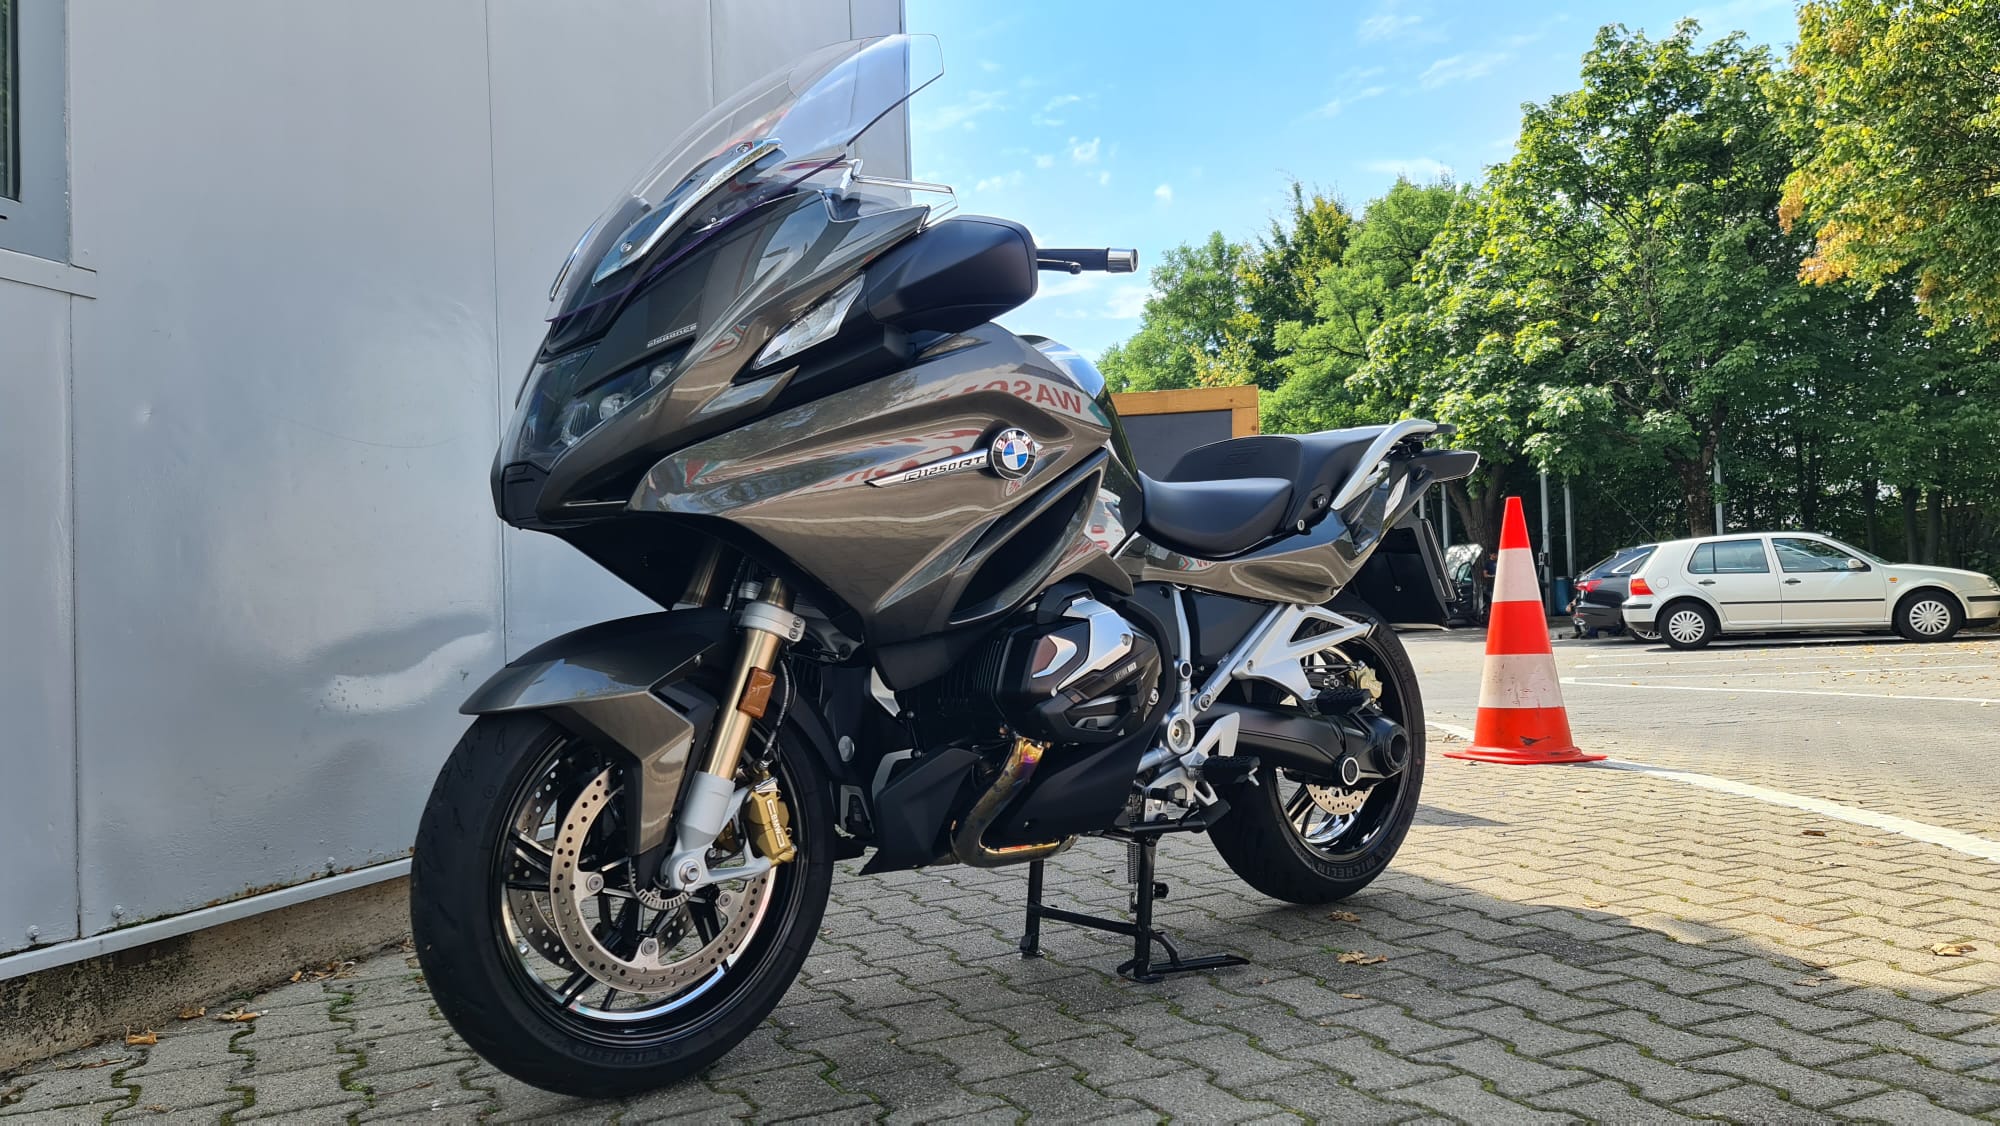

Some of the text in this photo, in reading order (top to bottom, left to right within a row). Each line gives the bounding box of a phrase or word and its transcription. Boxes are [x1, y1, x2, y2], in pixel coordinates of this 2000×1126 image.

[996, 431, 1032, 450] BMW
[771, 813, 782, 835] BMW
[1317, 856, 1376, 878] MICHELIN
